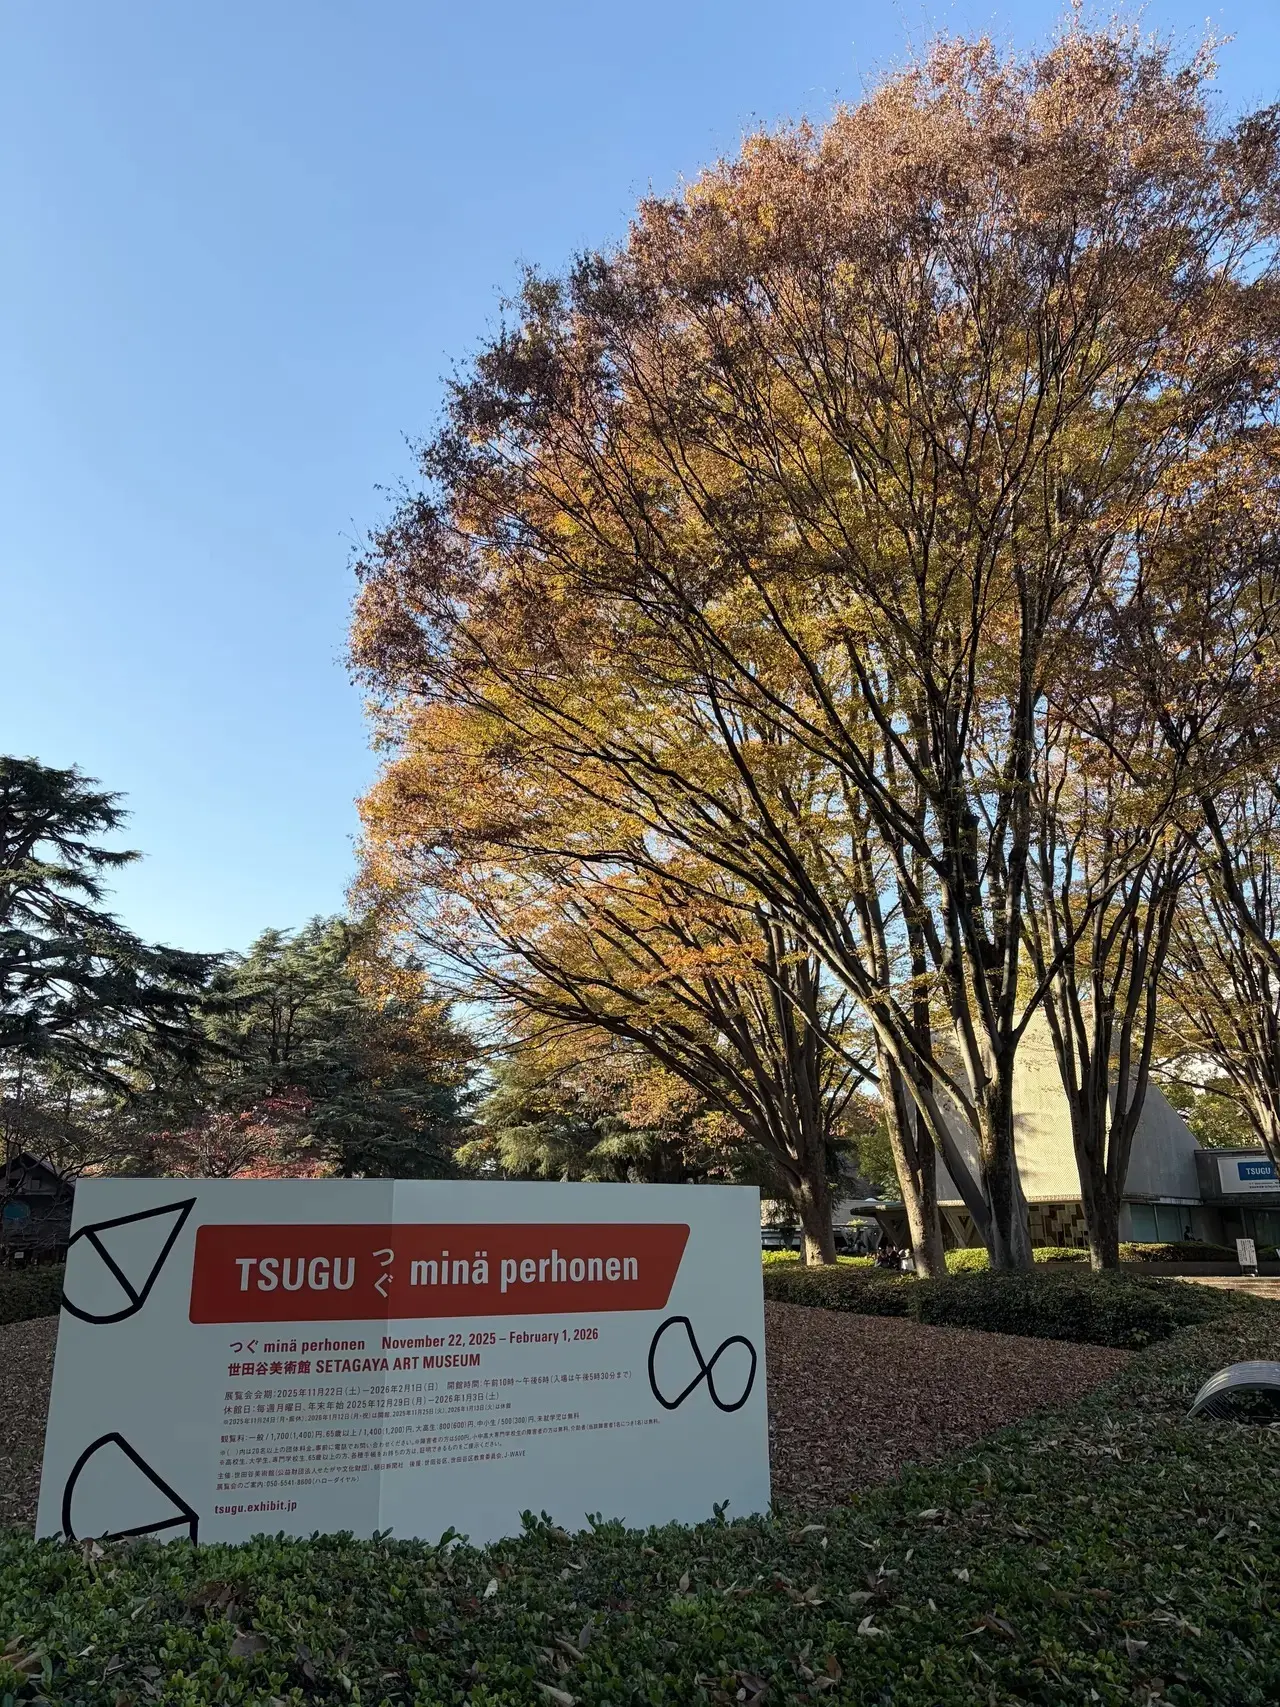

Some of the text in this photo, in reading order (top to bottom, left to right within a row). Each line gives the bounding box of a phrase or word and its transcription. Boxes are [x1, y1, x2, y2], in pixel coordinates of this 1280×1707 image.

[1245, 1167, 1271, 1175] TSUGU
[235, 1248, 638, 1298] TSUGU つぐ minä perhonen
[229, 1339, 259, 1354] つぐ
[263, 1339, 297, 1353] minä
[301, 1338, 365, 1354] perhonen
[381, 1335, 445, 1350] November
[448, 1334, 466, 1347] 22,
[468, 1332, 496, 1345] 2025
[509, 1331, 559, 1344] February
[561, 1329, 571, 1342] 1,
[573, 1328, 599, 1341] 2026
[227, 1353, 481, 1377] 世田谷美術館 SETAGAYA ART MUSEUM
[214, 1500, 297, 1515] tsugu.exhibit.jp
